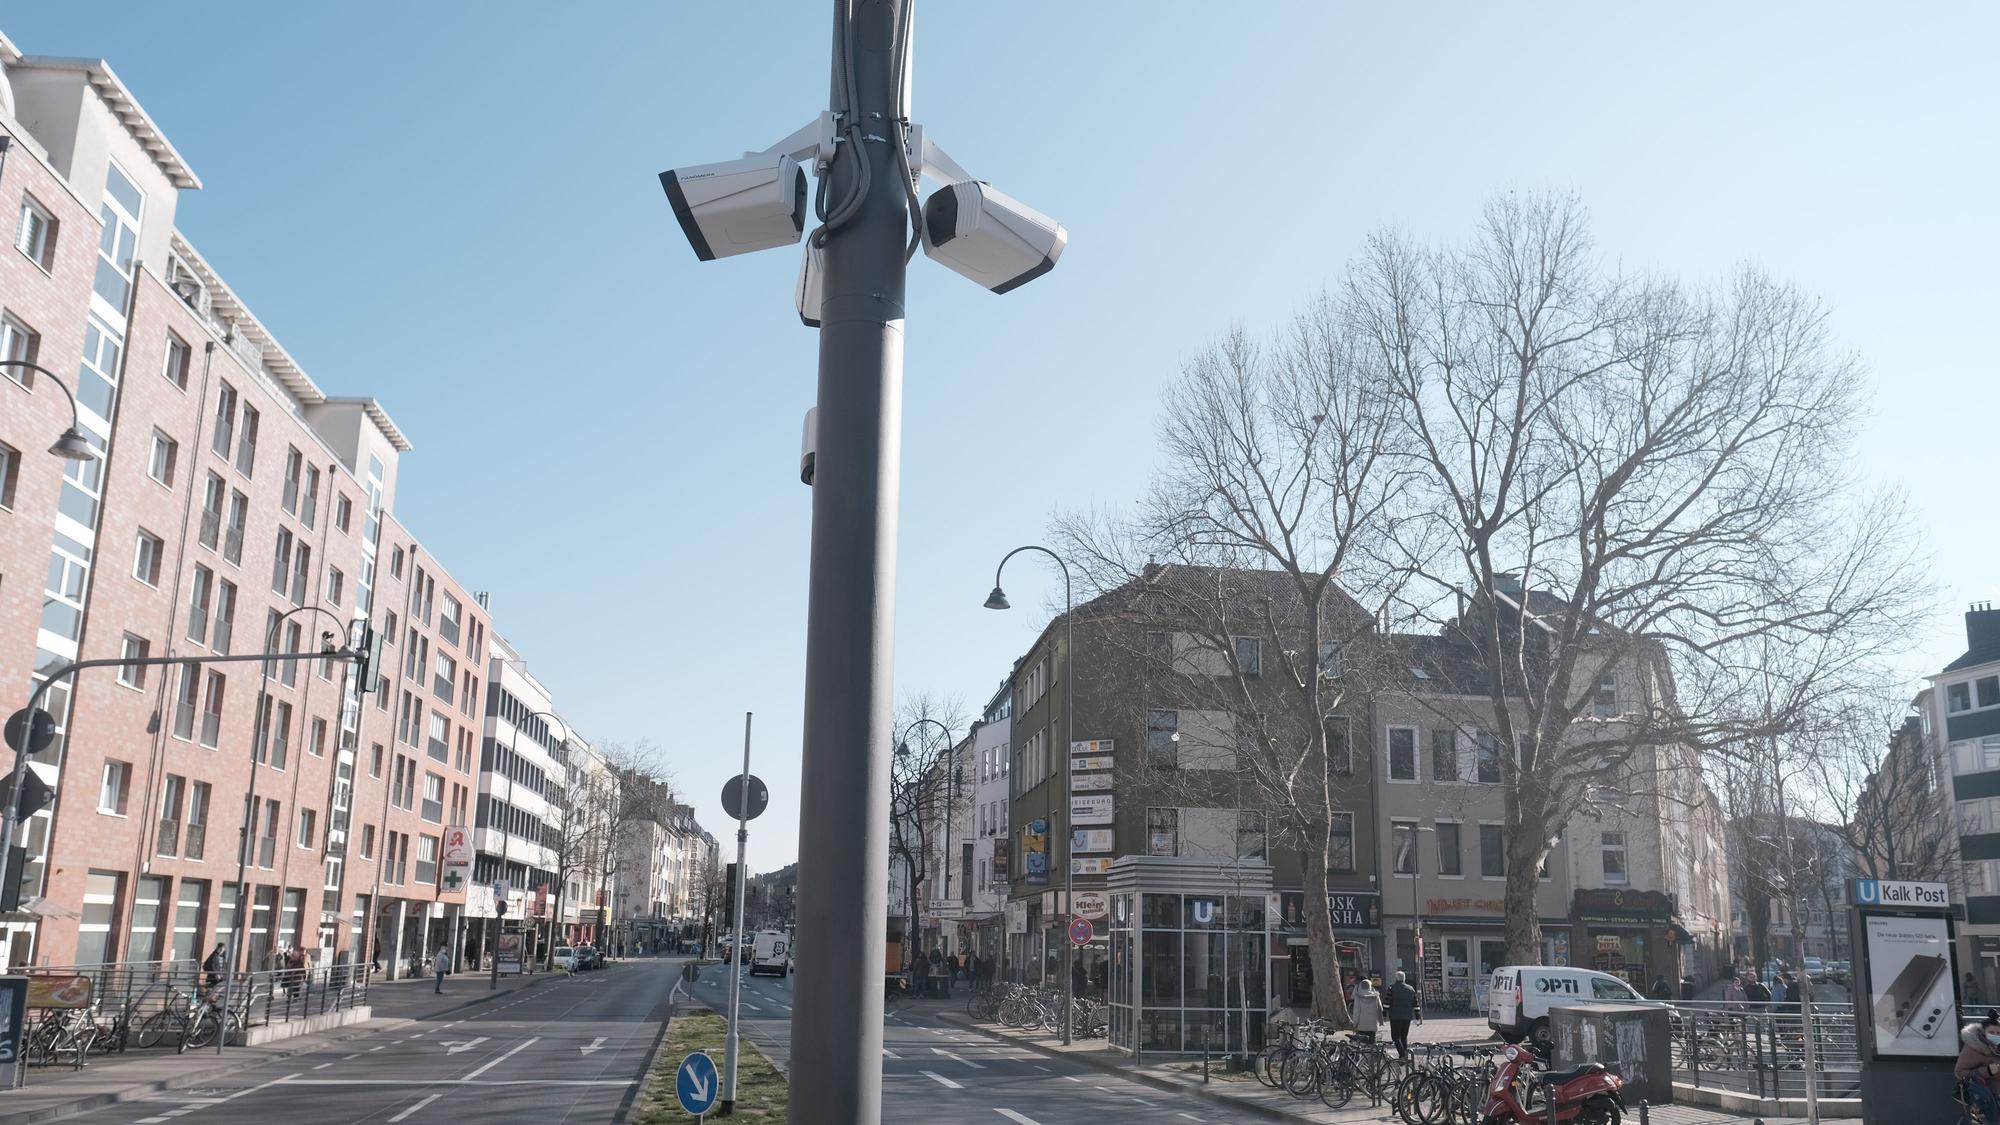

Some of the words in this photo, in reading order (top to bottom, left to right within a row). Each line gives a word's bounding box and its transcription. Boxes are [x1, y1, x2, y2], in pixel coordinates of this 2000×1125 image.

[1860, 882, 1876, 902] U
[1882, 885, 1911, 902] Kalk
[1915, 886, 1946, 903] Post
[1194, 901, 1213, 922] U
[1493, 975, 1514, 991] OPTI
[1535, 977, 1580, 994] OPTI
